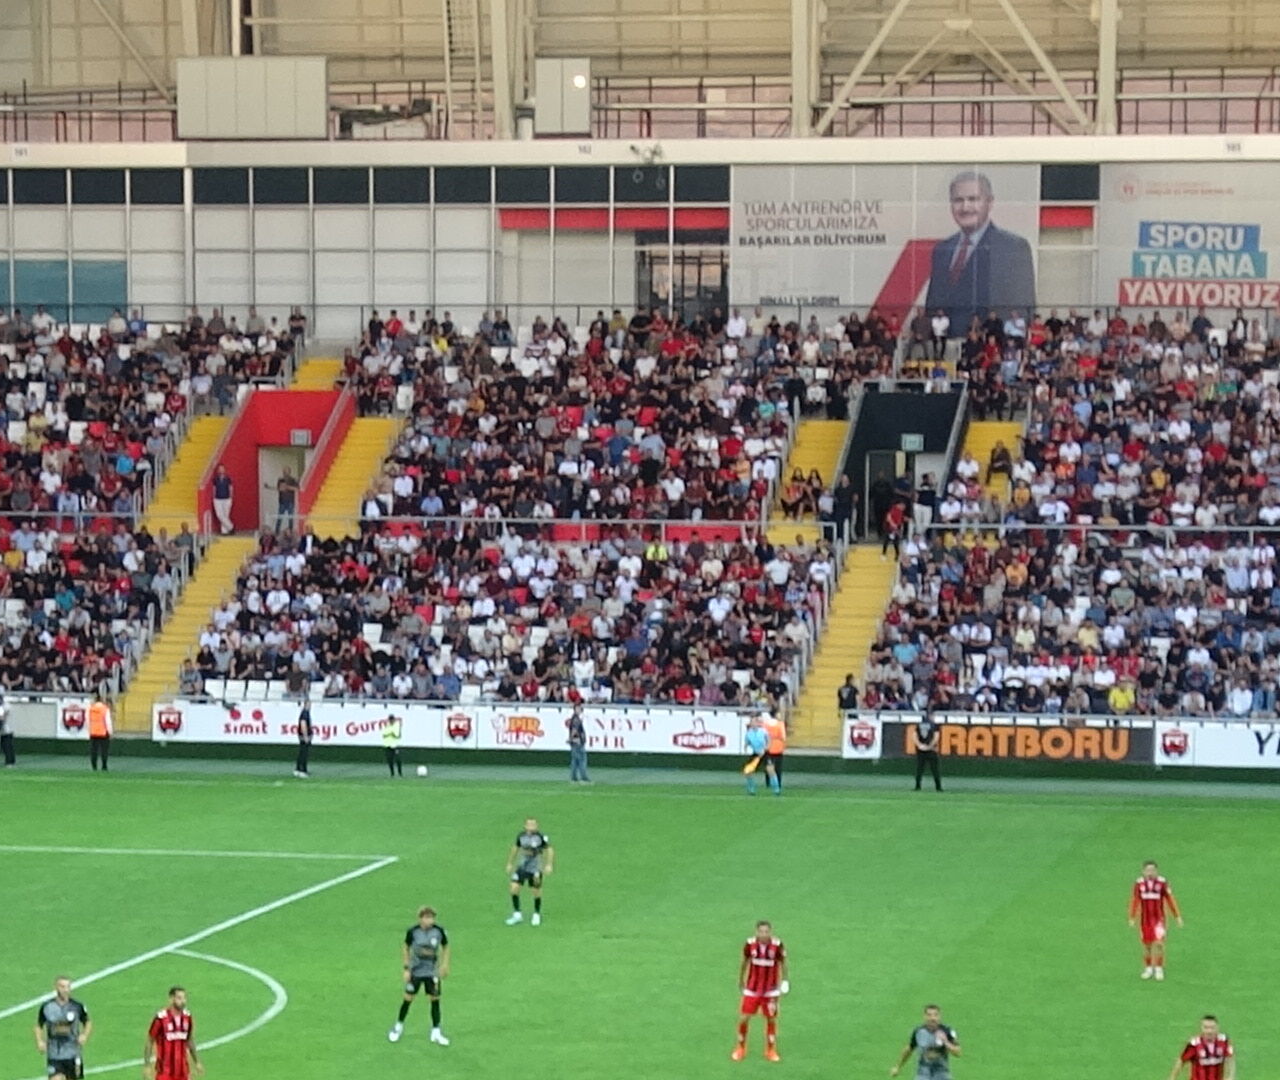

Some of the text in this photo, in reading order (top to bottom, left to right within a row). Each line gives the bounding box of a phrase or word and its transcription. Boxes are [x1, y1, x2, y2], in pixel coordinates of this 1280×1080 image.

[743, 198, 883, 216] TÜM ANTRENÖR VE
[746, 217, 878, 232] SPORCULARIMIZA
[739, 233, 887, 248] BAŞARILAR DİLİYORUM
[1148, 223, 1245, 251] SPORU
[1140, 252, 1256, 278] TABANA
[1121, 281, 1280, 308] YAYIYORUZ
